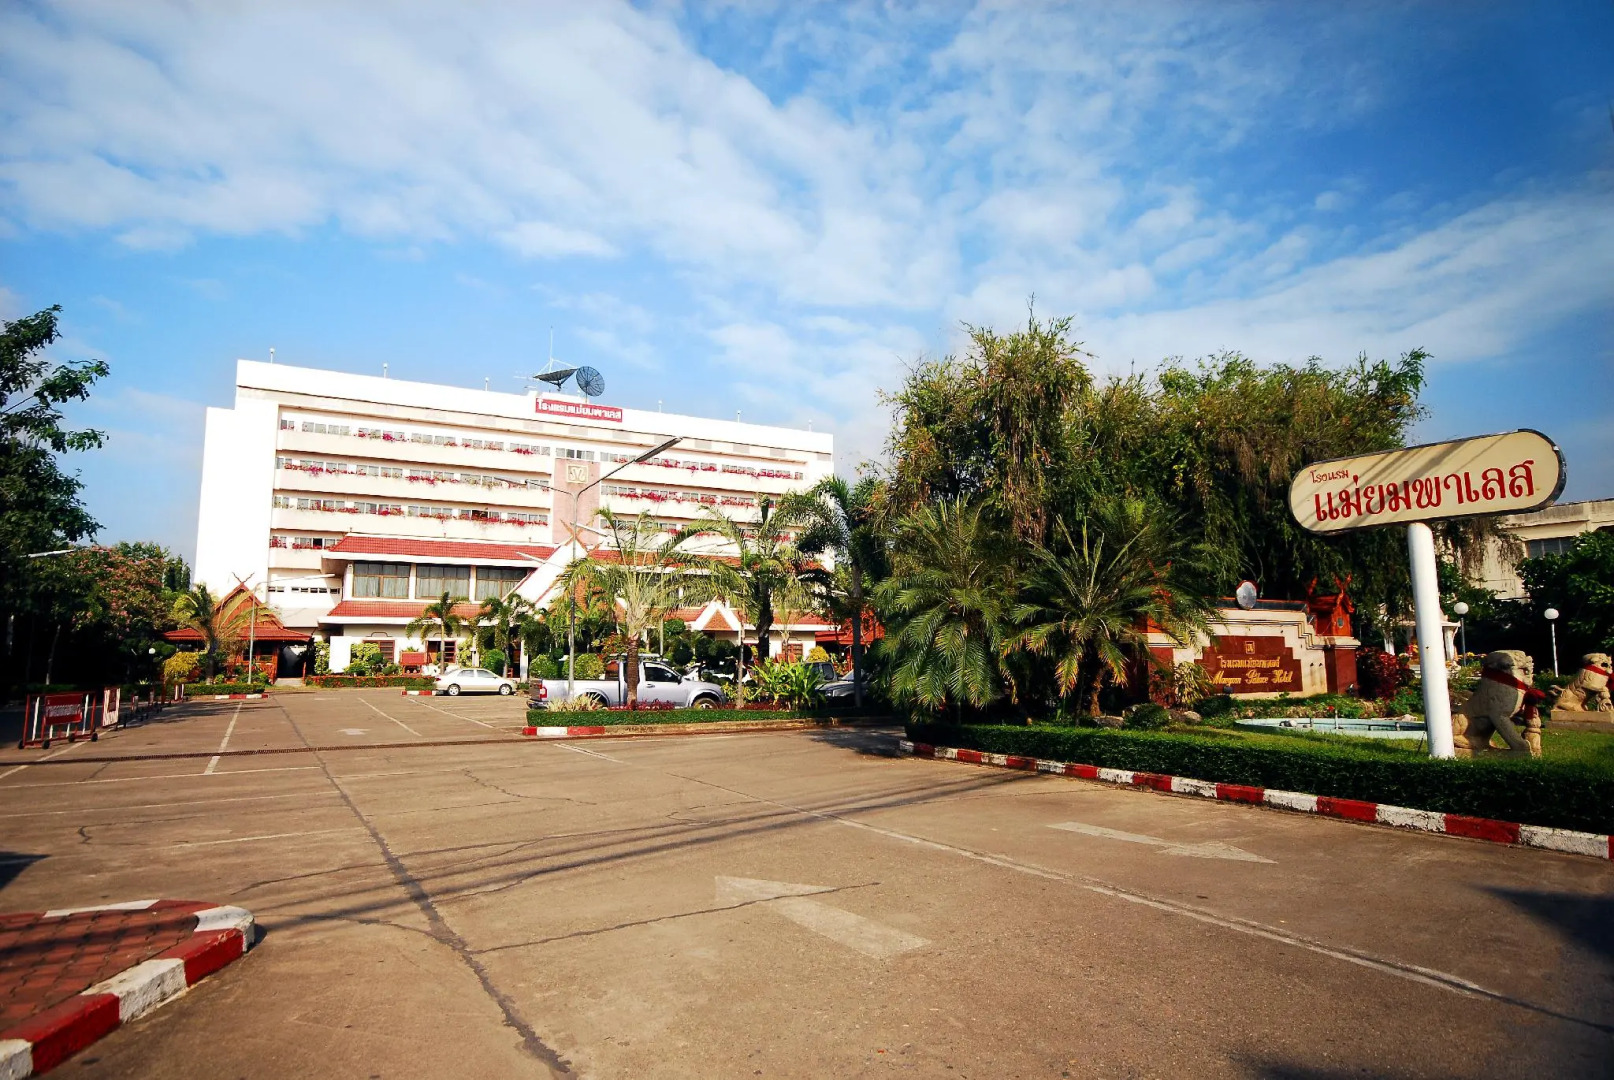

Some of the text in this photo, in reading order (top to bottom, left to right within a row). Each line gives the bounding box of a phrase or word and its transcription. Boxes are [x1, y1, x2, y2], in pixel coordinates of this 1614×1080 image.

[1310, 468, 1349, 484] โรงแรม
[1314, 460, 1534, 522] แม่ยมพาเลส
